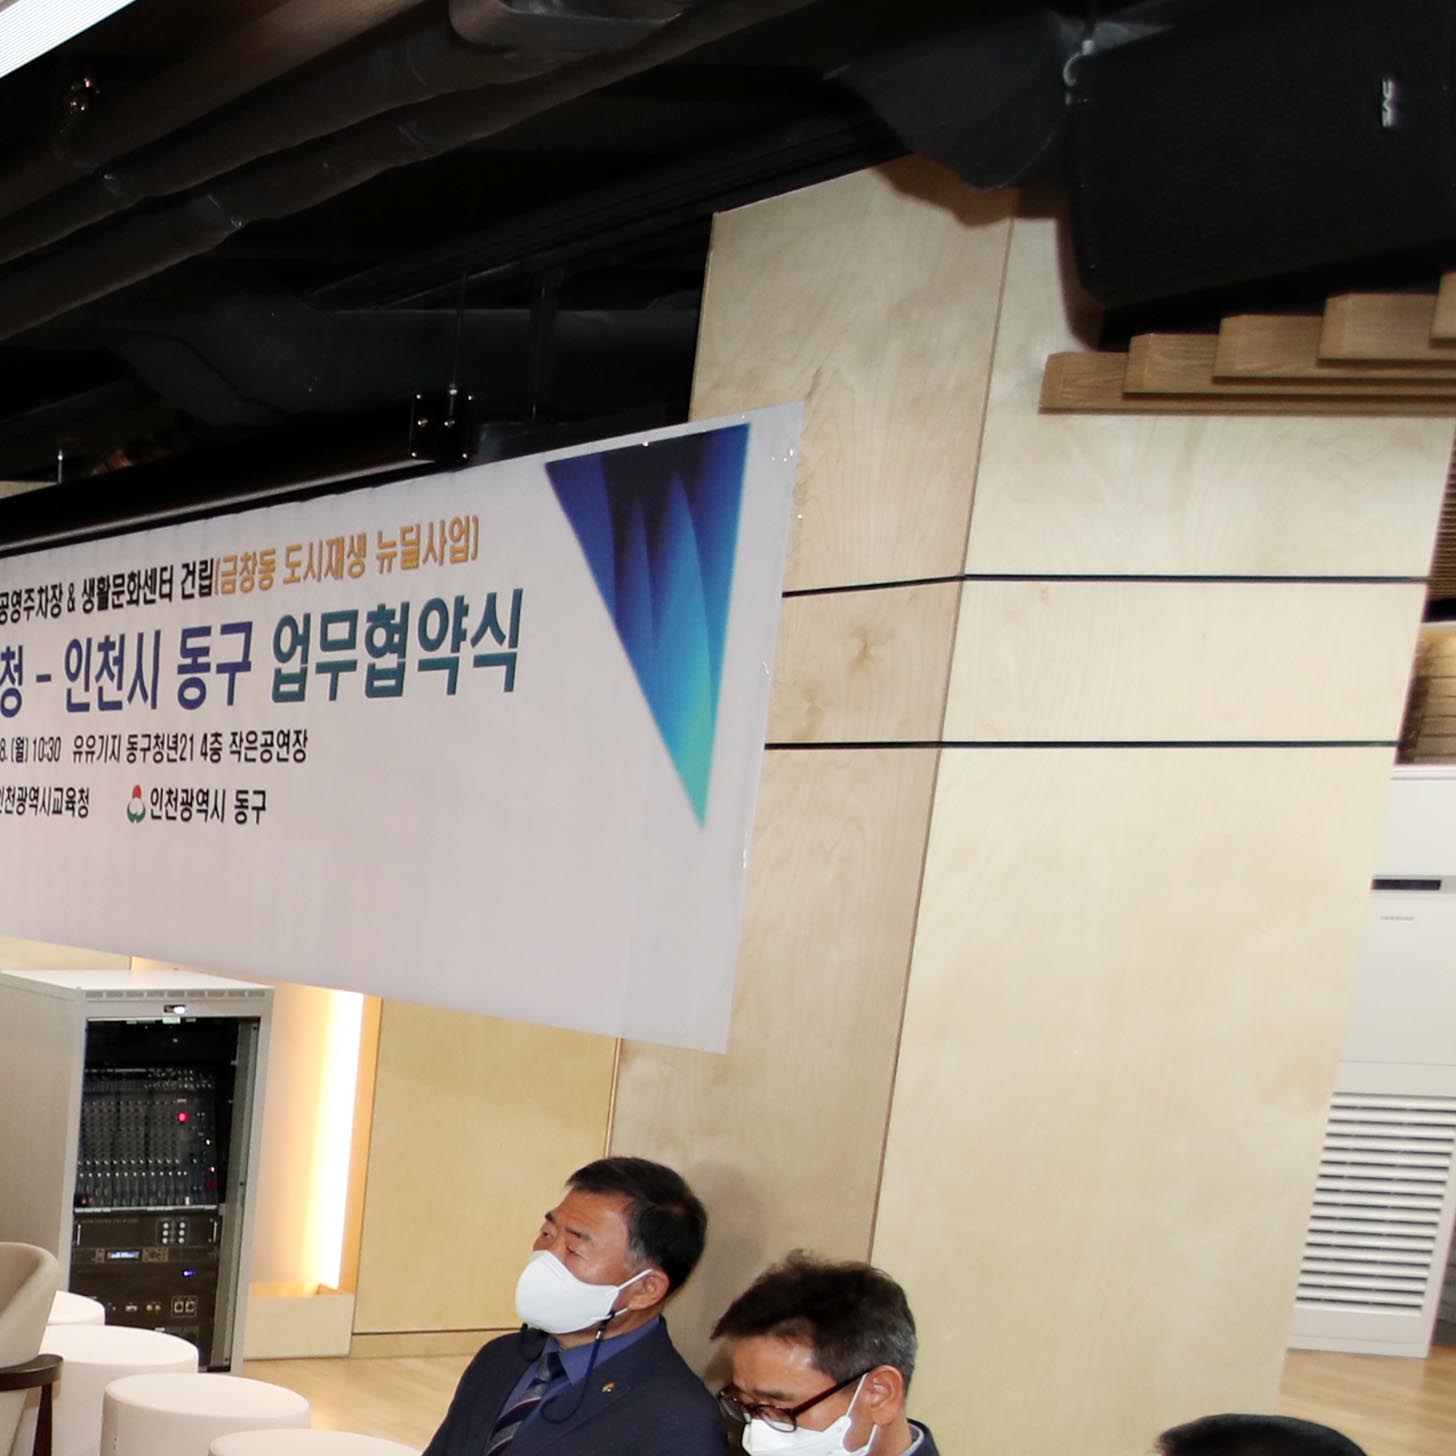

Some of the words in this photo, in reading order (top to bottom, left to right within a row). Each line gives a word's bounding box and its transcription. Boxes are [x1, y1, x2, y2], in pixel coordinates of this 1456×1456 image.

[68, 582, 75, 612] &
[81, 565, 174, 614] 생활문화센터
[283, 532, 368, 586] 도시재생
[375, 514, 479, 575] 뉴딜사업)
[64, 629, 161, 713] 인천시
[177, 621, 254, 711] 동구
[272, 588, 524, 704] 업무협약식
[32, 736, 62, 762] 10:30
[72, 734, 122, 764] 유유기지
[125, 733, 194, 764] 동구청년21
[200, 732, 224, 764] 4층
[229, 729, 308, 764] 작은공연장
[150, 787, 226, 823] 인천광역시
[234, 789, 267, 825] 동구
